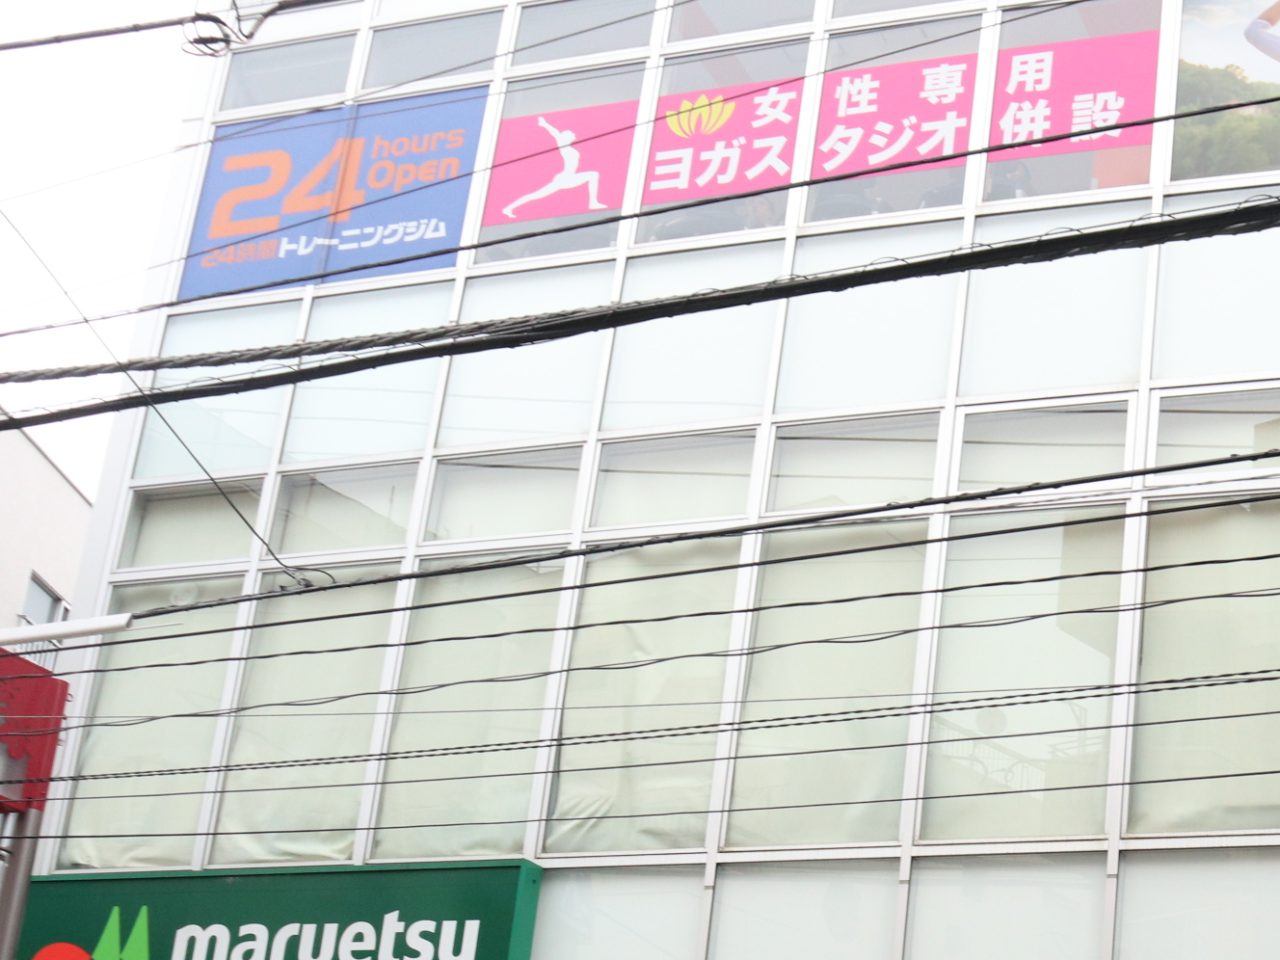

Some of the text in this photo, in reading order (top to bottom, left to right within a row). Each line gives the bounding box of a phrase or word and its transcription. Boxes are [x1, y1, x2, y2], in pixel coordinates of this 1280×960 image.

[371, 129, 465, 160] hours
[208, 137, 365, 239] 24
[366, 157, 461, 192] Open
